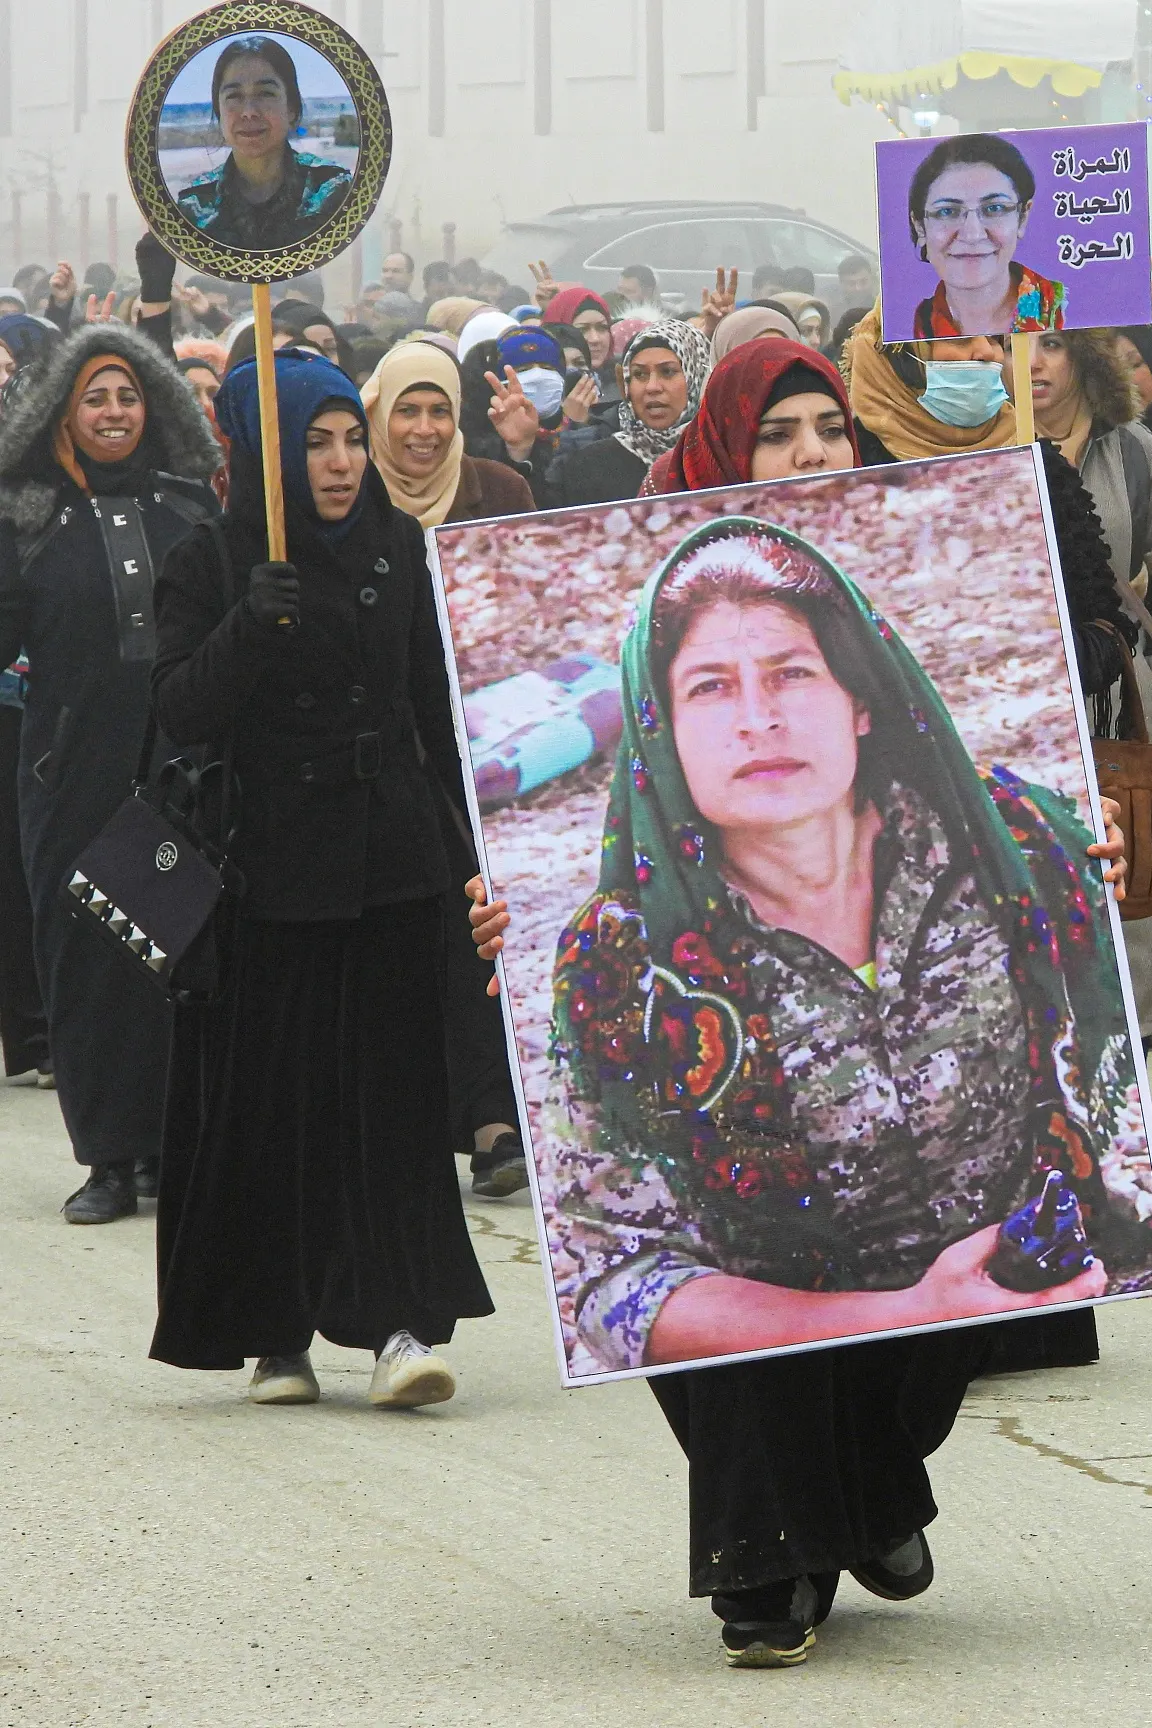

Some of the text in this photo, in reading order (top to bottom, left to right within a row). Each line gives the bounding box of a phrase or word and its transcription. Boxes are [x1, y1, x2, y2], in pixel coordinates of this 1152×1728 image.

[1052, 147, 1130, 181] المرأة
[1053, 188, 1131, 223] الحياة
[1057, 232, 1134, 268] الحرة
